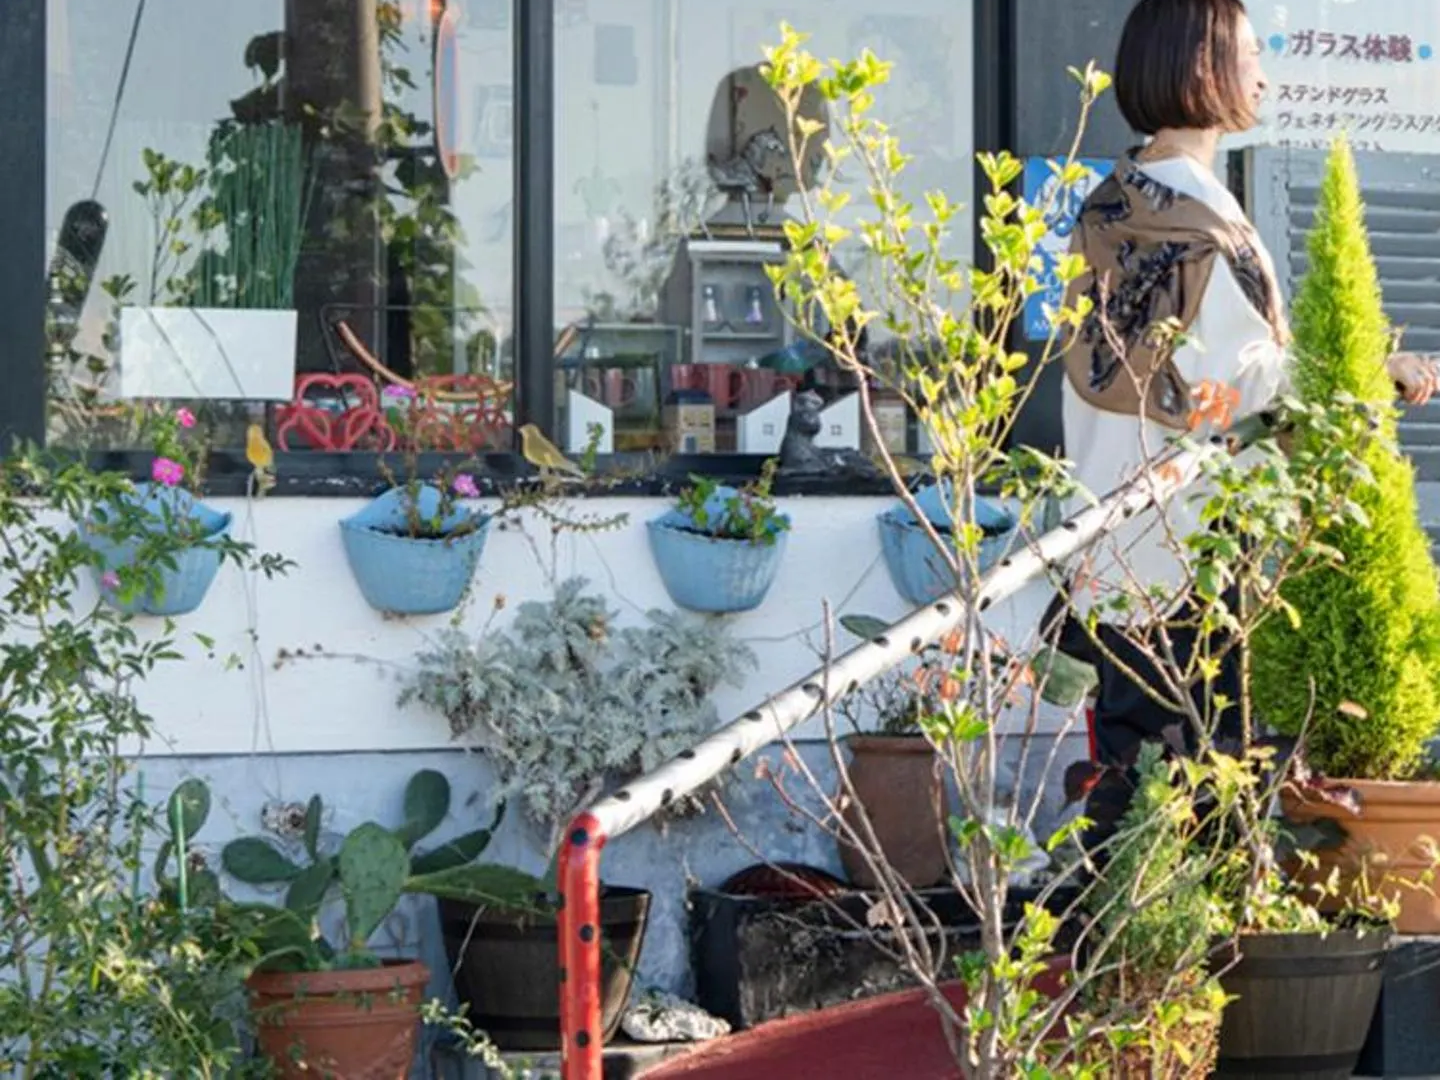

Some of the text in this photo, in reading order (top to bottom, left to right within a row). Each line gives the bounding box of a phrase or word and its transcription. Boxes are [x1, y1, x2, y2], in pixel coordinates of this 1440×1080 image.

[1290, 28, 1414, 63] ガラス体験
[1277, 83, 1389, 106] ステンドグラス
